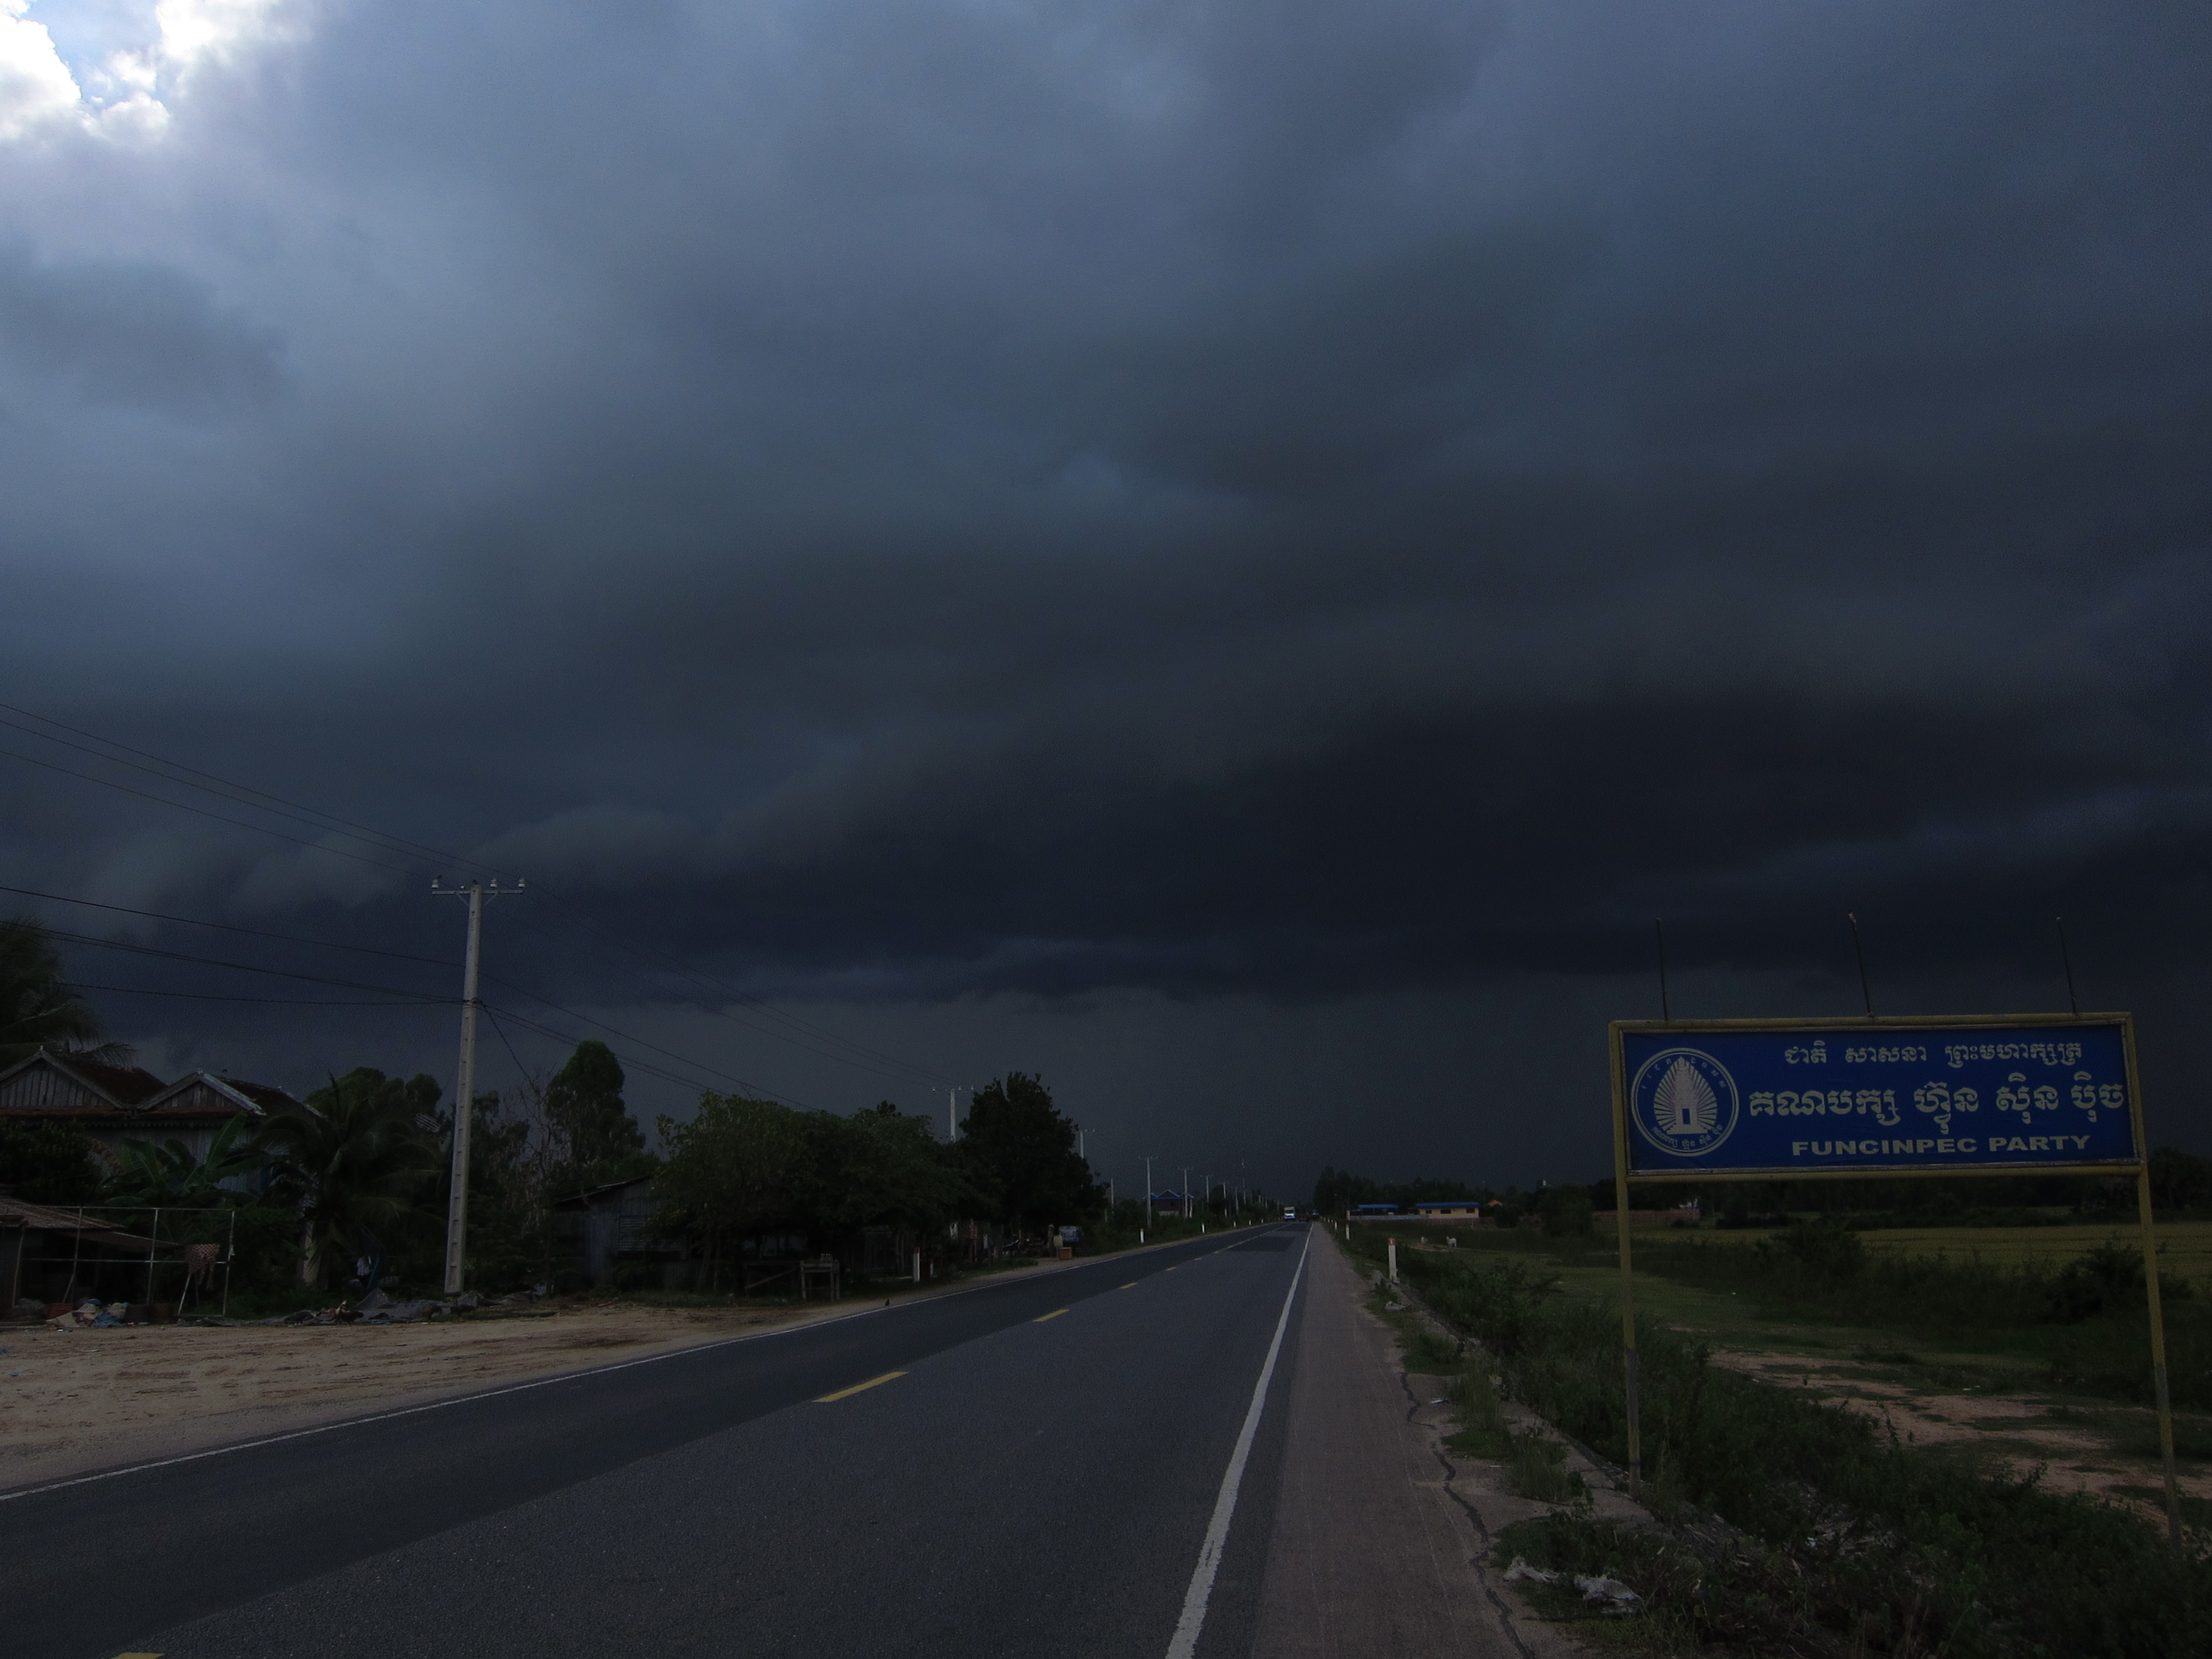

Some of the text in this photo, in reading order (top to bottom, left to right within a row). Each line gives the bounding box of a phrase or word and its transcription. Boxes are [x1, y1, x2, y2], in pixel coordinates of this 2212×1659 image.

[1784, 1039, 2082, 1068] ជាតិ សាសនា ព្រះមហាក្សត្រ
[1749, 1090, 1902, 1127] គណបក្ស
[1792, 1135, 2091, 1156] FUNCINPEC PARTY
